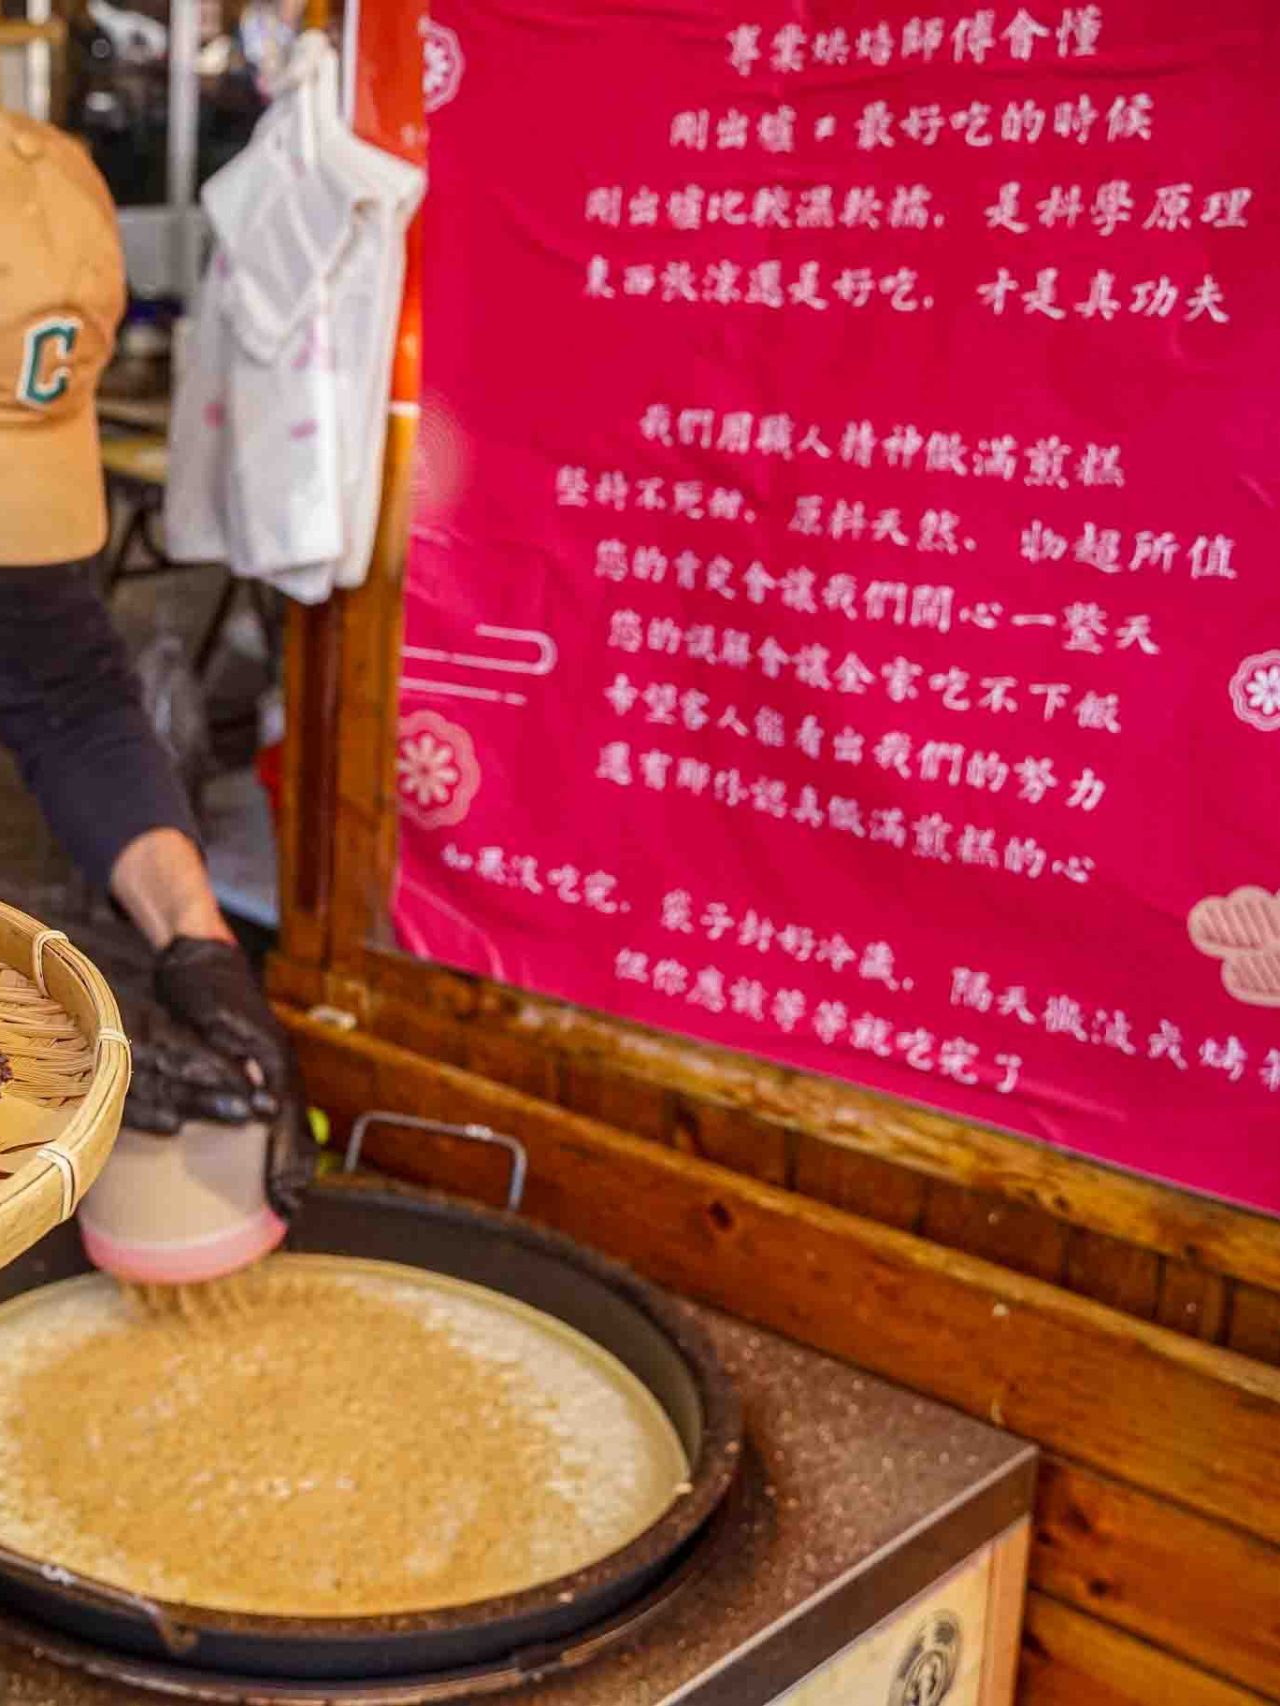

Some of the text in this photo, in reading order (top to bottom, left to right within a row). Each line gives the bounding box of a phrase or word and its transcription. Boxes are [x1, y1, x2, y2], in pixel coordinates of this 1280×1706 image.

[986, 181, 1251, 235] 是科學原理
[978, 268, 1228, 322] 才是真功夫
[17, 317, 82, 406] C
[1022, 521, 1235, 578] 物超所值
